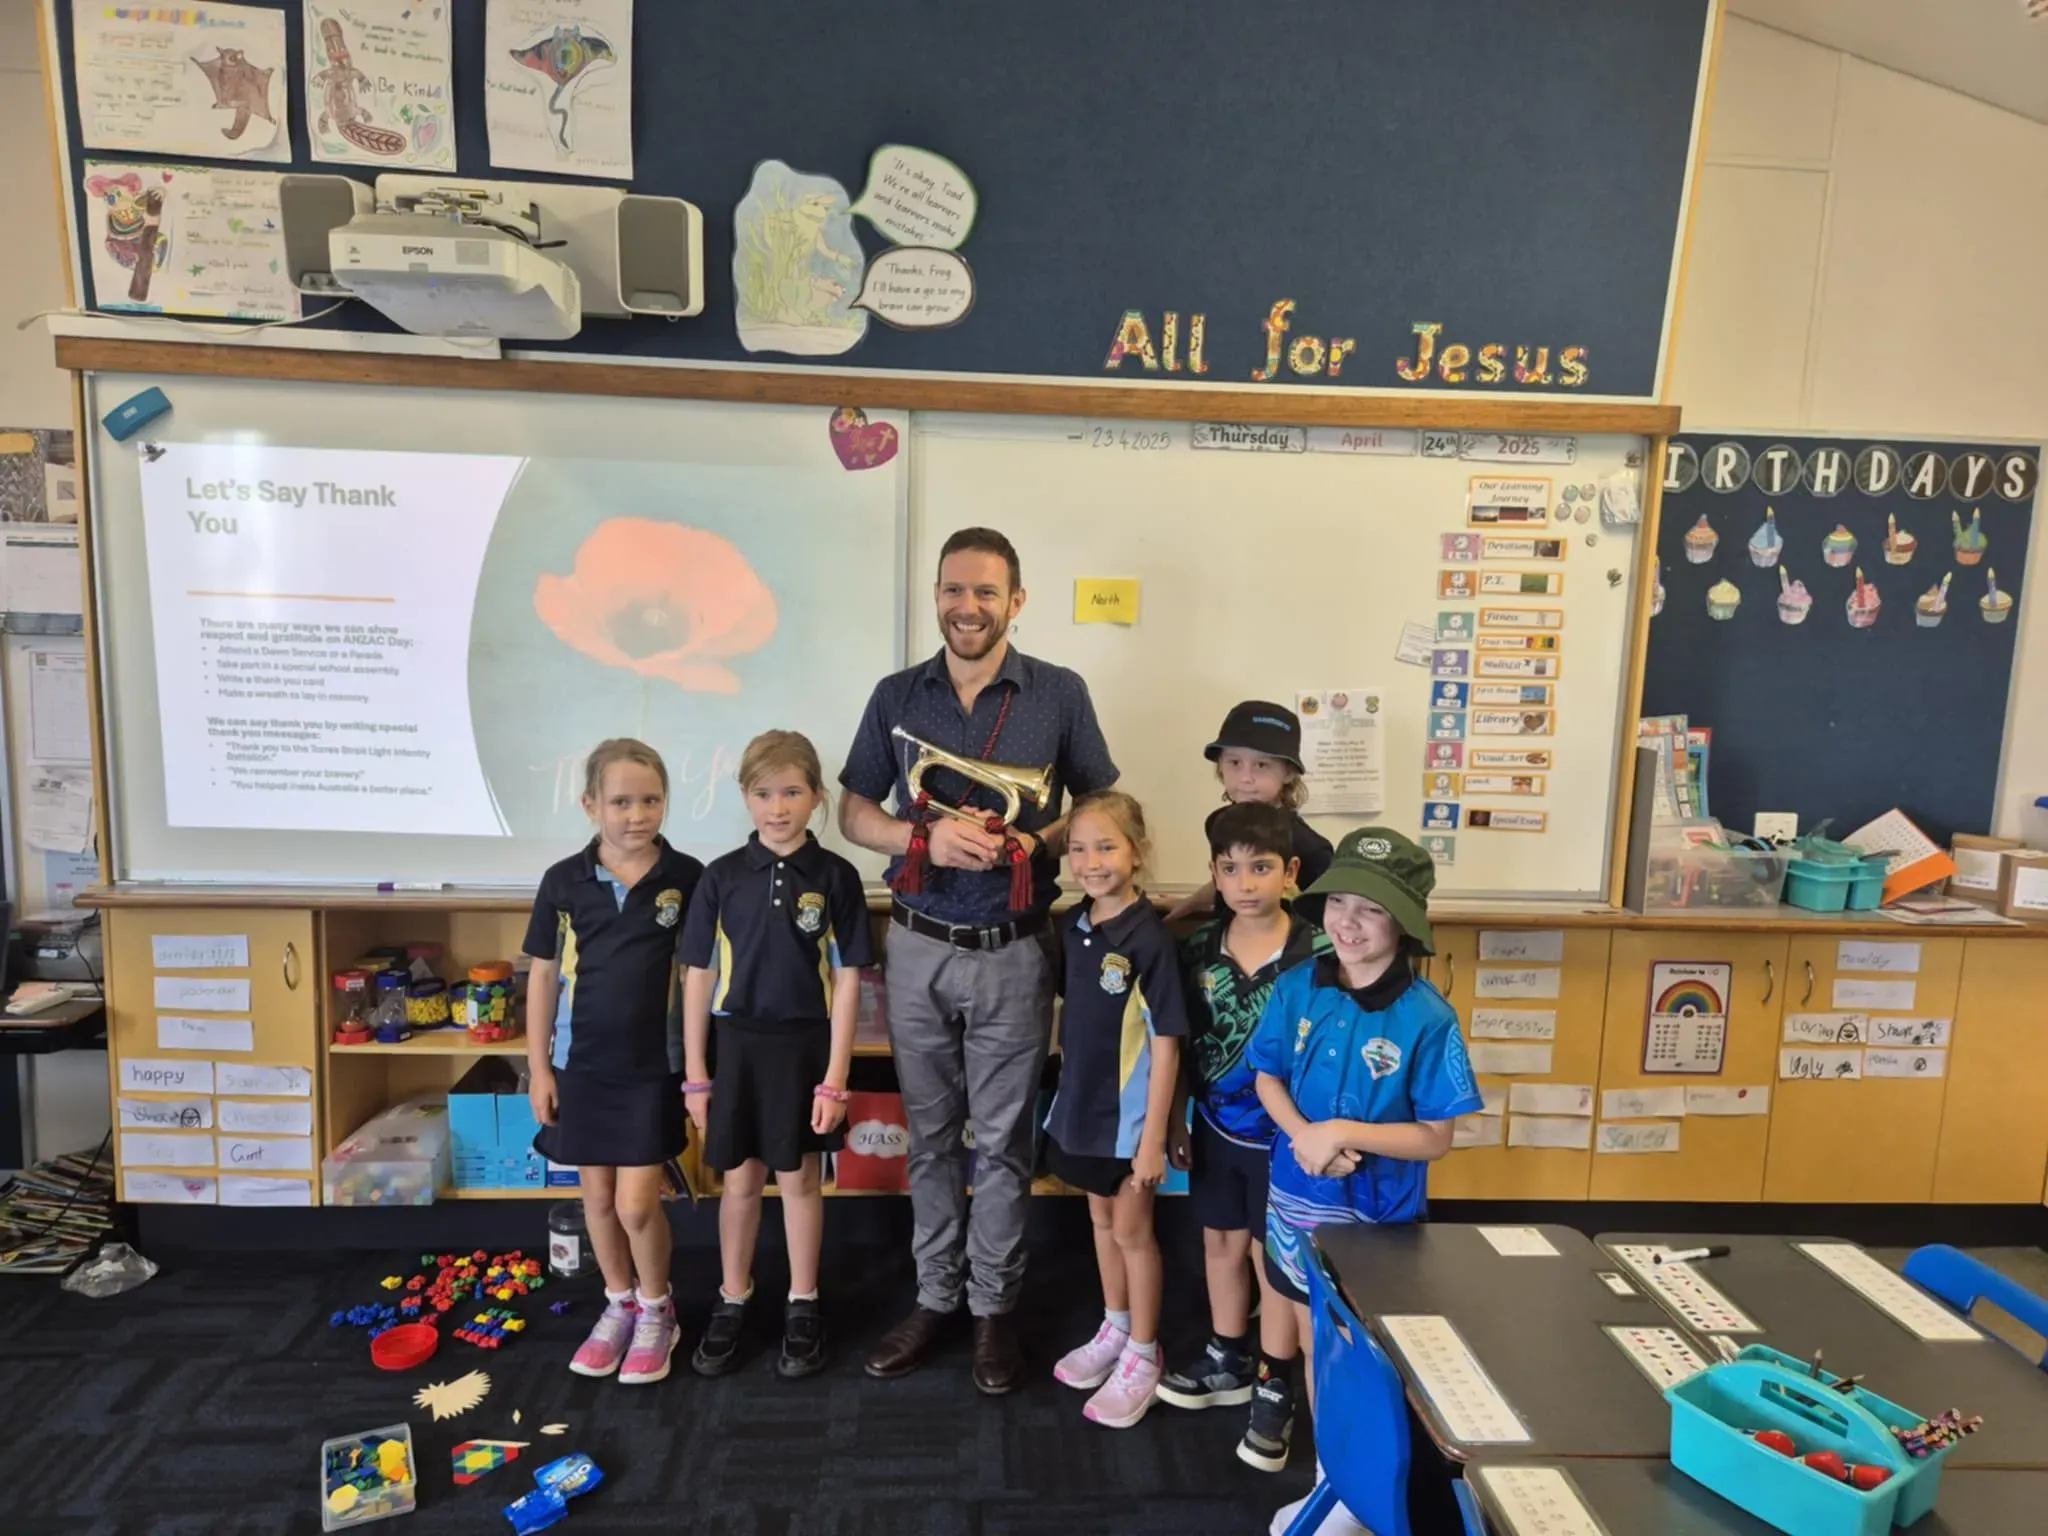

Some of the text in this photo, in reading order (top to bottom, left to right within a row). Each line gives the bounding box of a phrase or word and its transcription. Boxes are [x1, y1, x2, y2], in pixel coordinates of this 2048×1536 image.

[378, 77, 396, 93] Be
[873, 191, 957, 237] and learners make
[926, 192, 961, 220] learners
[402, 246, 433, 256] EPSON
[888, 281, 911, 294] have
[923, 288, 935, 299] go
[938, 288, 948, 296] so
[950, 289, 966, 300] my
[878, 299, 904, 310] brain
[1104, 298, 1590, 387] All for Jesus
[1209, 426, 1289, 448] Thursday
[1340, 432, 1383, 450] April
[1424, 436, 1458, 451] 24th
[1498, 438, 1540, 455] 2025
[185, 477, 397, 508] Let's Say Thank
[1479, 481, 1544, 493] Our Learning
[1489, 493, 1529, 504] Journey
[188, 510, 238, 535] You
[200, 618, 399, 635] There are many ways we can show
[201, 631, 414, 648] respect and gratitude on ANZAC Day:
[292, 647, 327, 658] Service
[217, 660, 239, 669] Take
[282, 662, 316, 673] special
[319, 663, 351, 672] school
[354, 665, 400, 676] assembly
[254, 675, 281, 684] thank
[284, 677, 301, 686] you
[303, 676, 325, 686] card
[218, 688, 245, 697] Make
[255, 690, 288, 699] wreath
[302, 691, 316, 702] lay
[329, 692, 369, 703] memory
[207, 716, 418, 733] We can say thank you by writing special
[1476, 714, 1520, 727] Library
[208, 727, 239, 737] thank
[241, 729, 261, 739] you
[262, 743, 279, 753] you
[293, 744, 309, 753] the
[311, 744, 339, 754] Torres
[369, 746, 391, 757] Light
[250, 767, 299, 777] remember
[302, 769, 322, 779] your
[255, 781, 288, 792] helped
[318, 783, 359, 793] Australia
[369, 785, 397, 794] better
[1789, 1055, 1824, 1079] Ugly
[132, 1065, 185, 1086] happy
[858, 1132, 903, 1146] HASS
